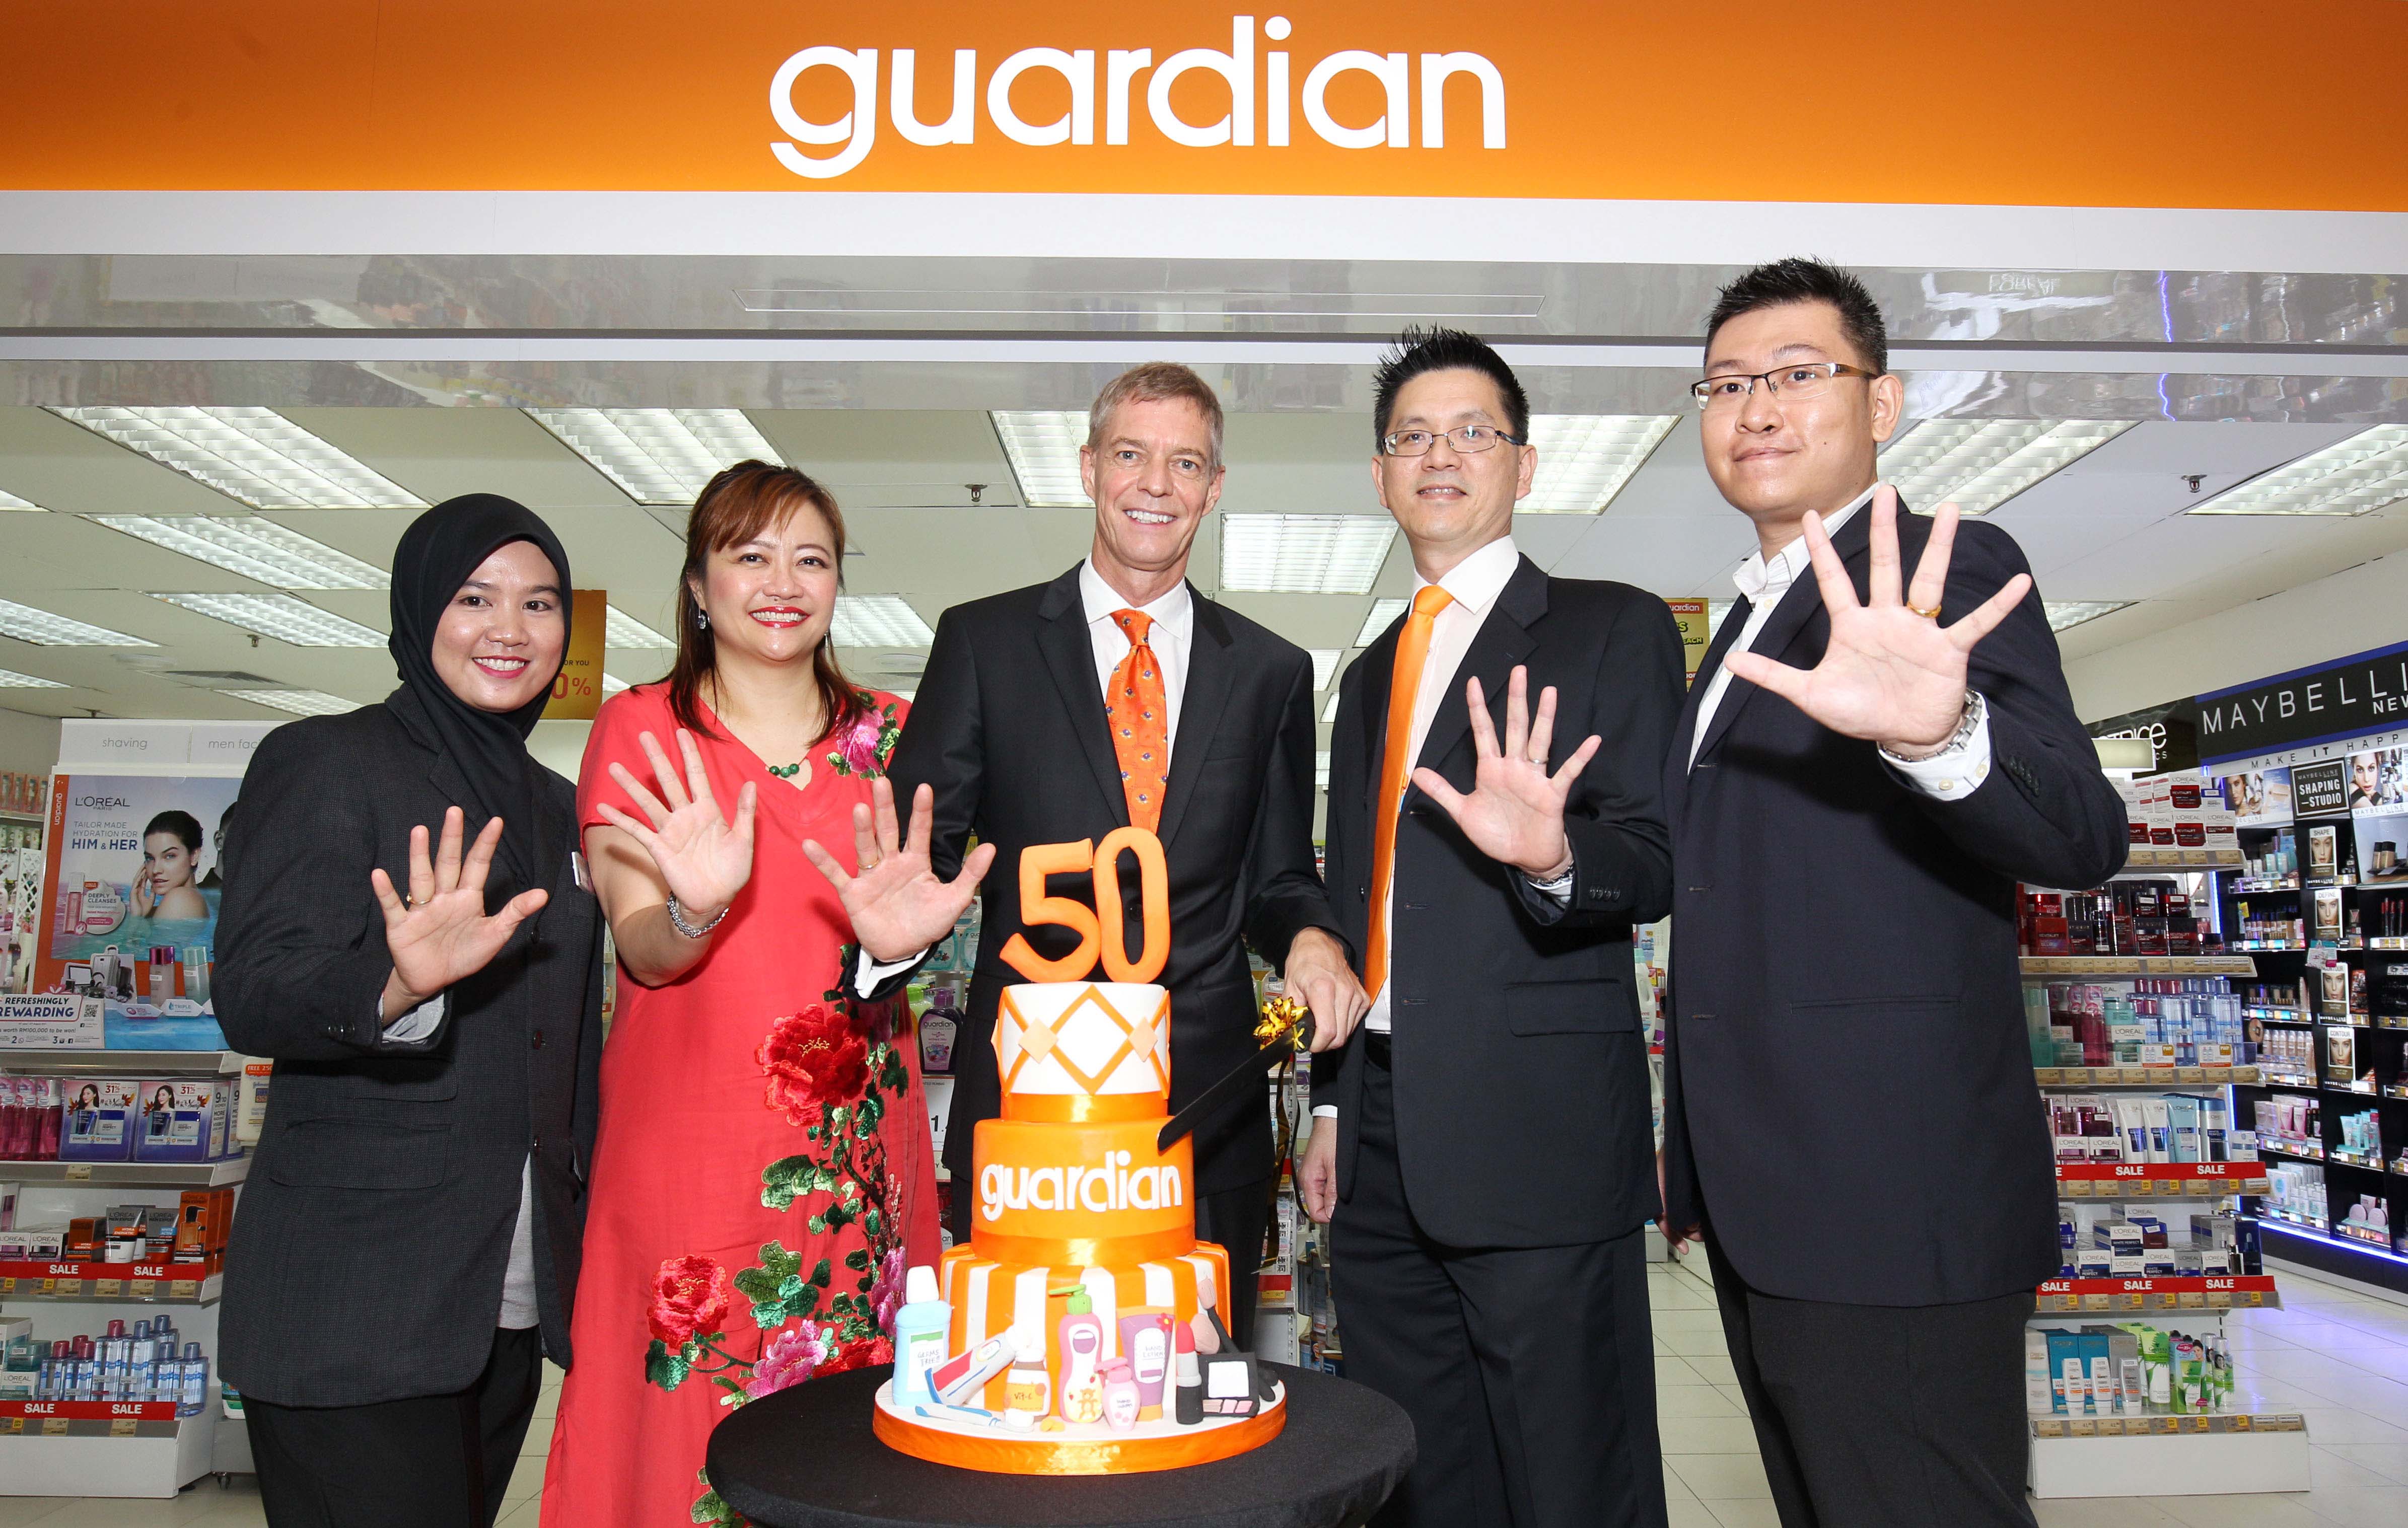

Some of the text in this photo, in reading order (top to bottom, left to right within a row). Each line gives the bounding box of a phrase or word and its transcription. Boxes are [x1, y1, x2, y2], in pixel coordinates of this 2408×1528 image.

[769, 16, 1507, 179] guardian
[102, 738, 148, 750] shaving
[208, 741, 235, 749] men
[2251, 753, 2296, 769] MAKE
[2313, 747, 2329, 758] IT
[2298, 769, 2338, 779] MAYBELLINE
[2299, 779, 2341, 795] SHAPING
[54, 792, 62, 826] guardian
[2355, 805, 2404, 815] MAYBELLINE
[72, 839, 98, 850] HIM
[109, 839, 137, 850] HER
[999, 826, 1171, 984] 50
[2115, 1166, 2144, 1176] SALE
[2197, 1165, 2225, 1175] SALE
[981, 1150, 1182, 1222] guardian
[49, 1265, 79, 1274] SALE
[133, 1266, 164, 1276] SALE
[2041, 1282, 2071, 1292] SALE
[2123, 1280, 2153, 1290] SALE
[2206, 1279, 2234, 1289] SALE
[24, 1403, 55, 1413] SALE
[111, 1404, 143, 1414] SALE
